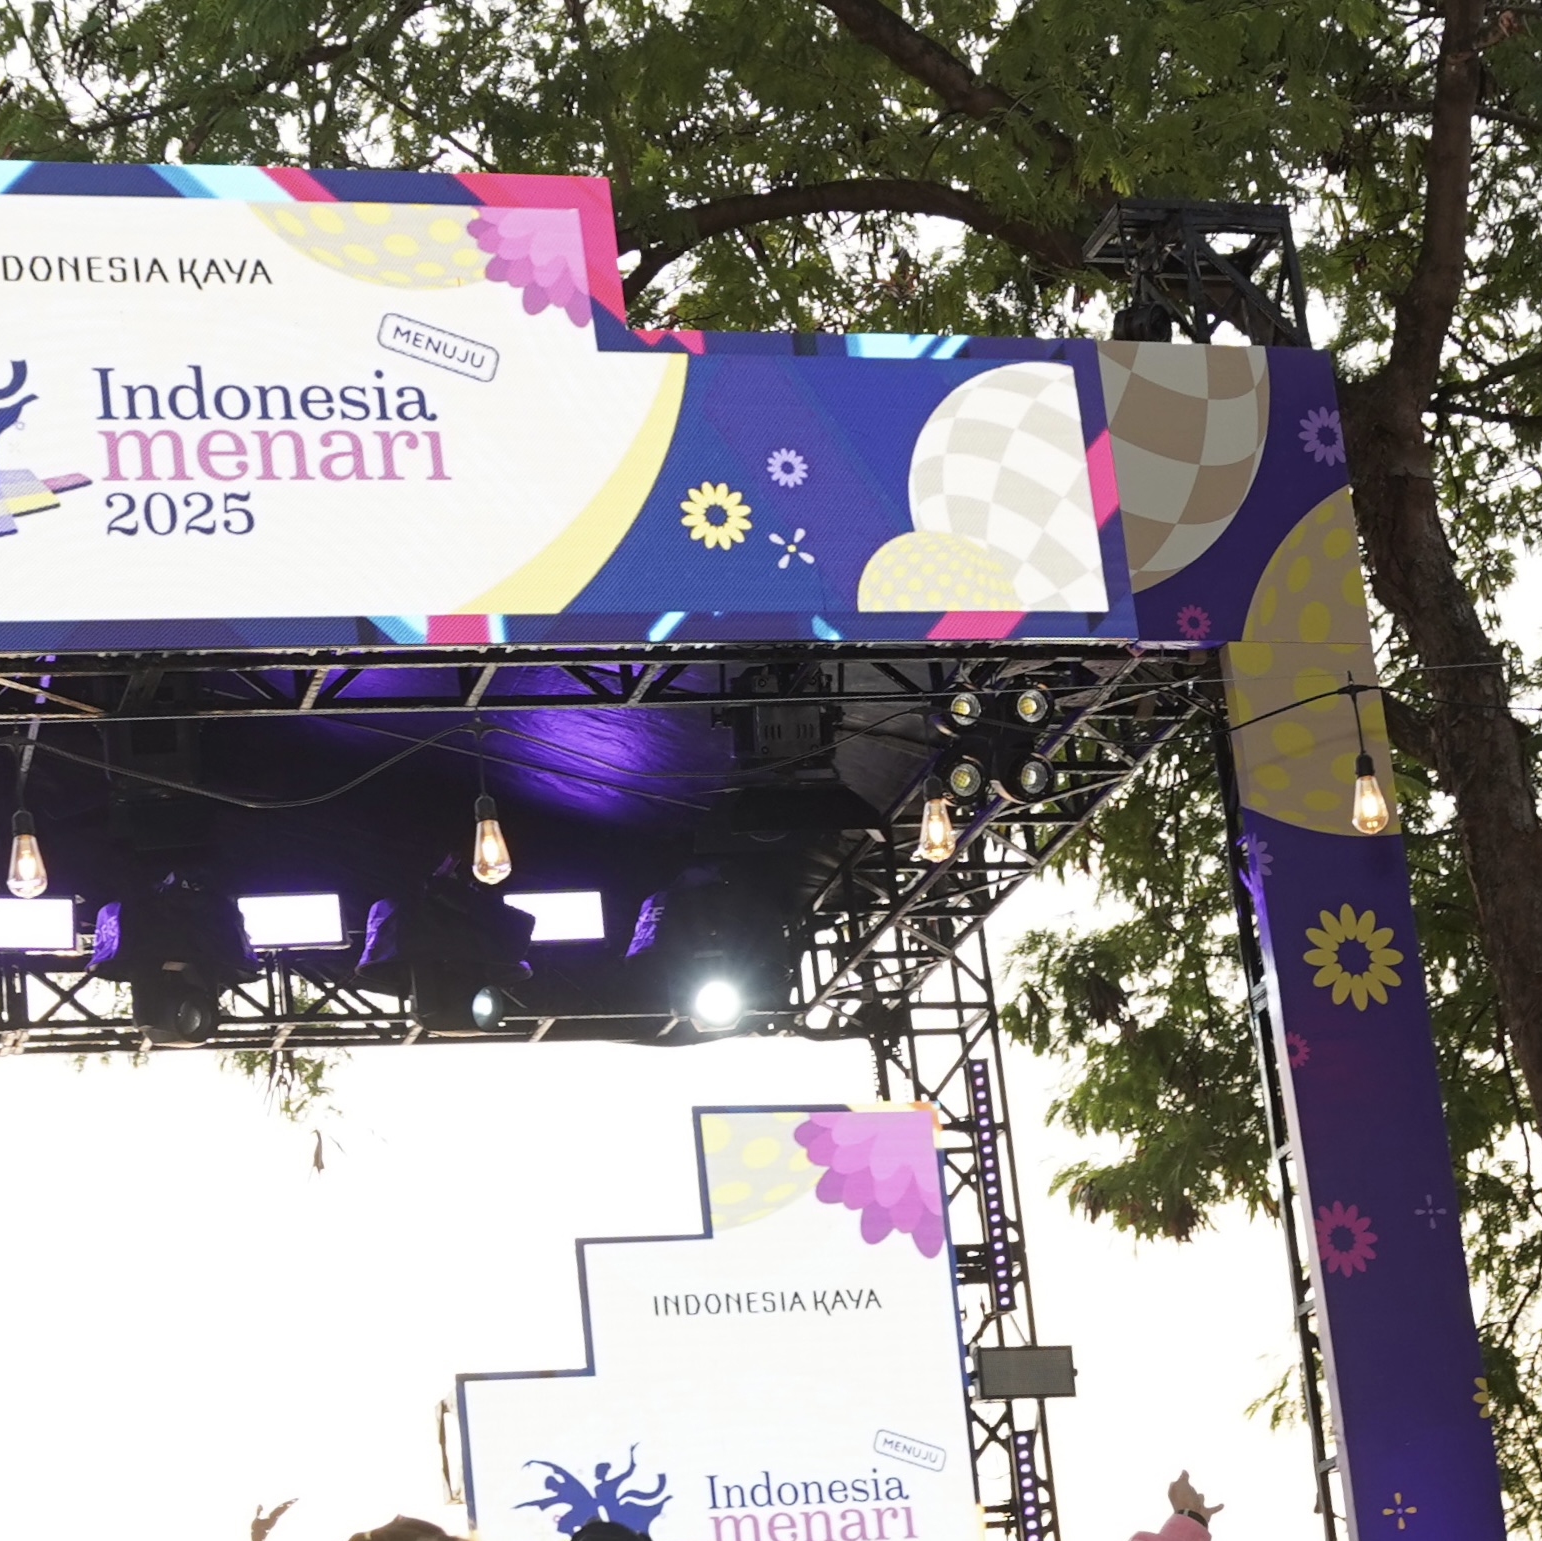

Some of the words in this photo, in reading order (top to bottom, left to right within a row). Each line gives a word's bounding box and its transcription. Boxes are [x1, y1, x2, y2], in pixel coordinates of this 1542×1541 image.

[176, 257, 274, 290] KAYA
[392, 324, 487, 372] MENUJU
[91, 364, 438, 423] Indonesia
[99, 428, 452, 482] menari
[105, 490, 256, 537] 2025
[653, 1290, 807, 1317] INDONESIA
[812, 1288, 883, 1318] KAYA
[882, 1437, 939, 1464] MENUJU
[707, 1468, 910, 1511] Indonesia
